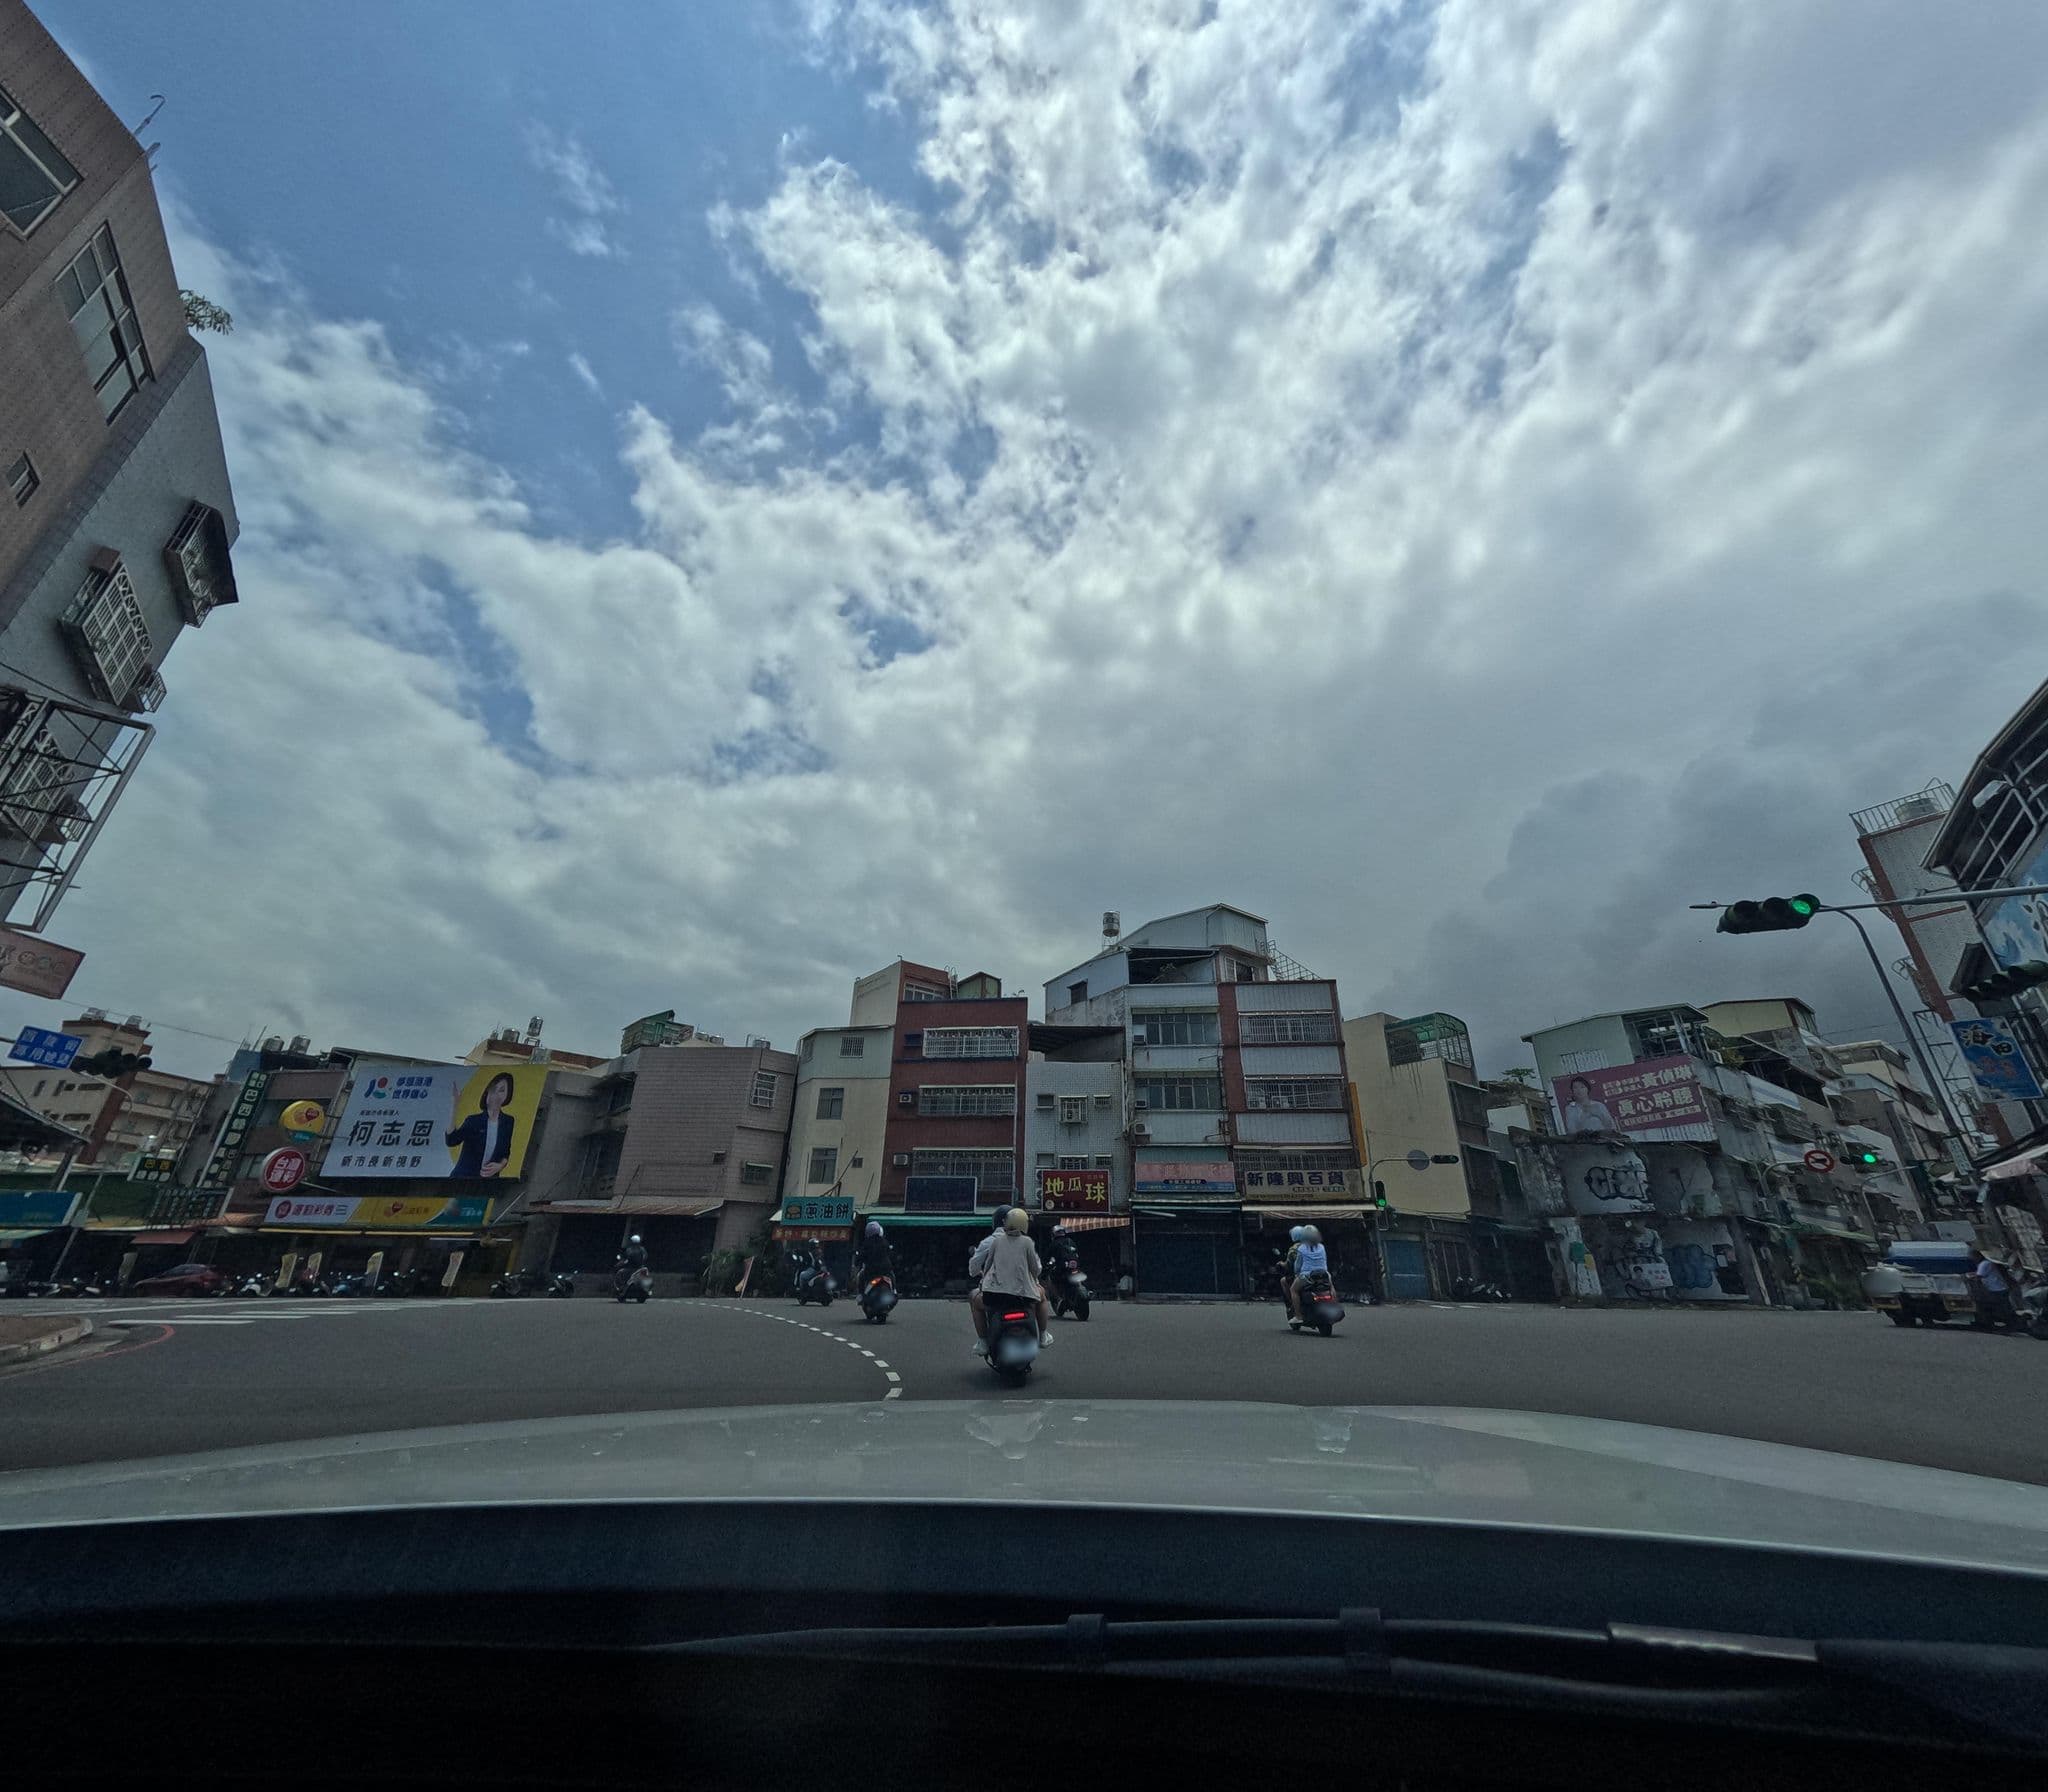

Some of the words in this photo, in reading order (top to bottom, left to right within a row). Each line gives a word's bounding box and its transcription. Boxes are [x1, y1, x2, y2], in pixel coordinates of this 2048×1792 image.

[347, 1120, 434, 1147] 柯志恩
[341, 1155, 422, 1168] 新市長新視野
[1247, 1171, 1345, 1186] 新隆興百貨
[1044, 1176, 1106, 1204] 地瓜球
